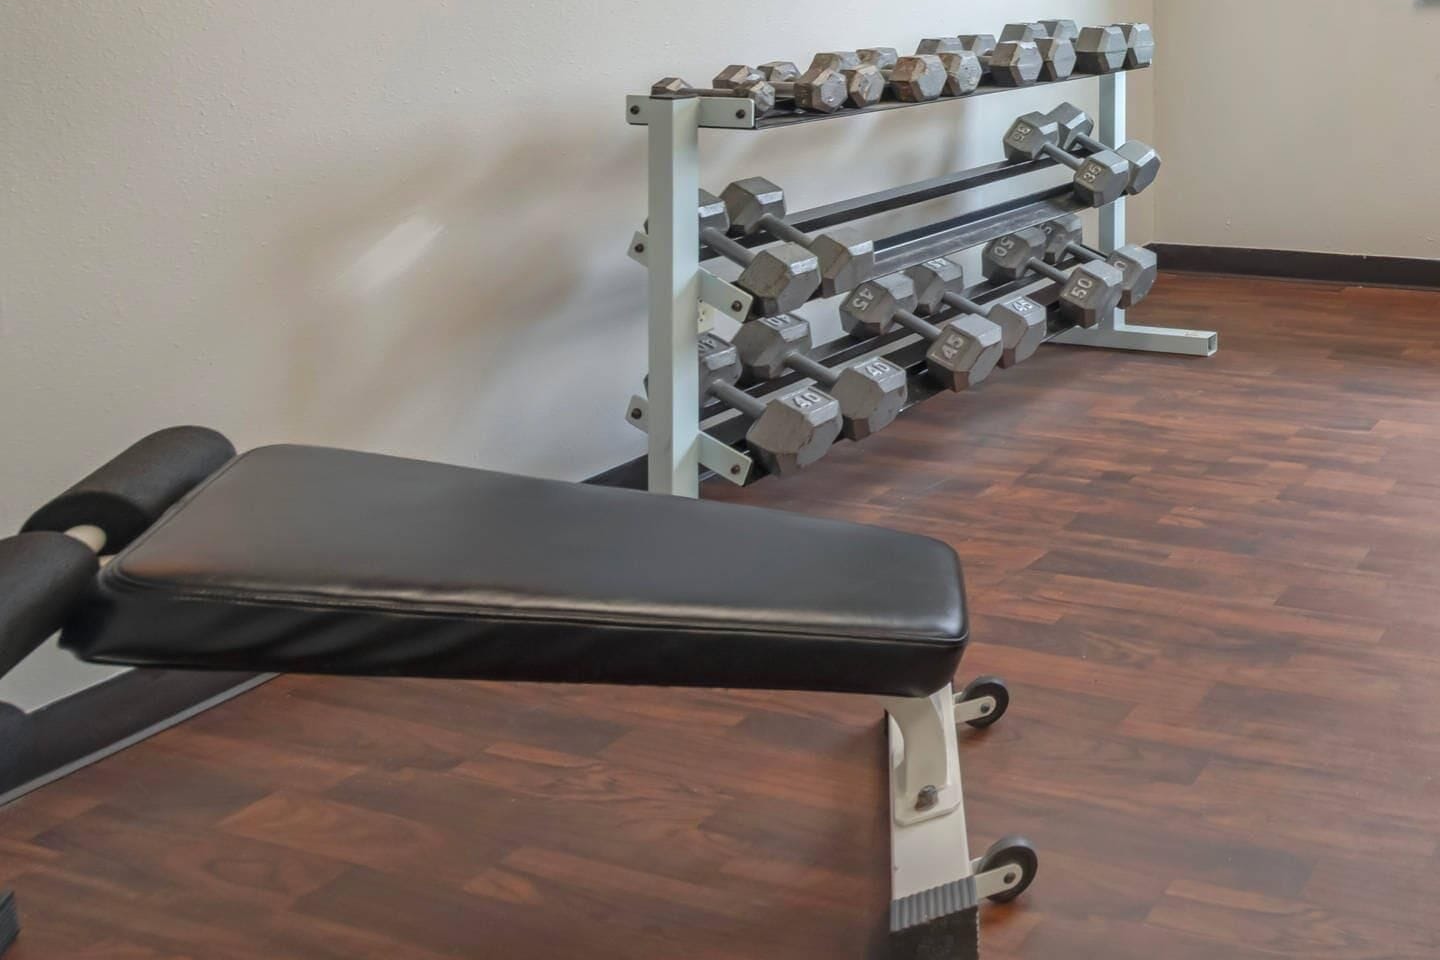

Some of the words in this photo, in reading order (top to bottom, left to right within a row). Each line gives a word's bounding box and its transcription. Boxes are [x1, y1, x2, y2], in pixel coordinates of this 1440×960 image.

[1083, 165, 1102, 183] 35
[993, 236, 1016, 257] 50
[851, 287, 876, 311] 45
[1069, 277, 1094, 300] 50
[941, 334, 965, 361] 45
[862, 362, 892, 378] 40
[793, 391, 822, 410] 40
